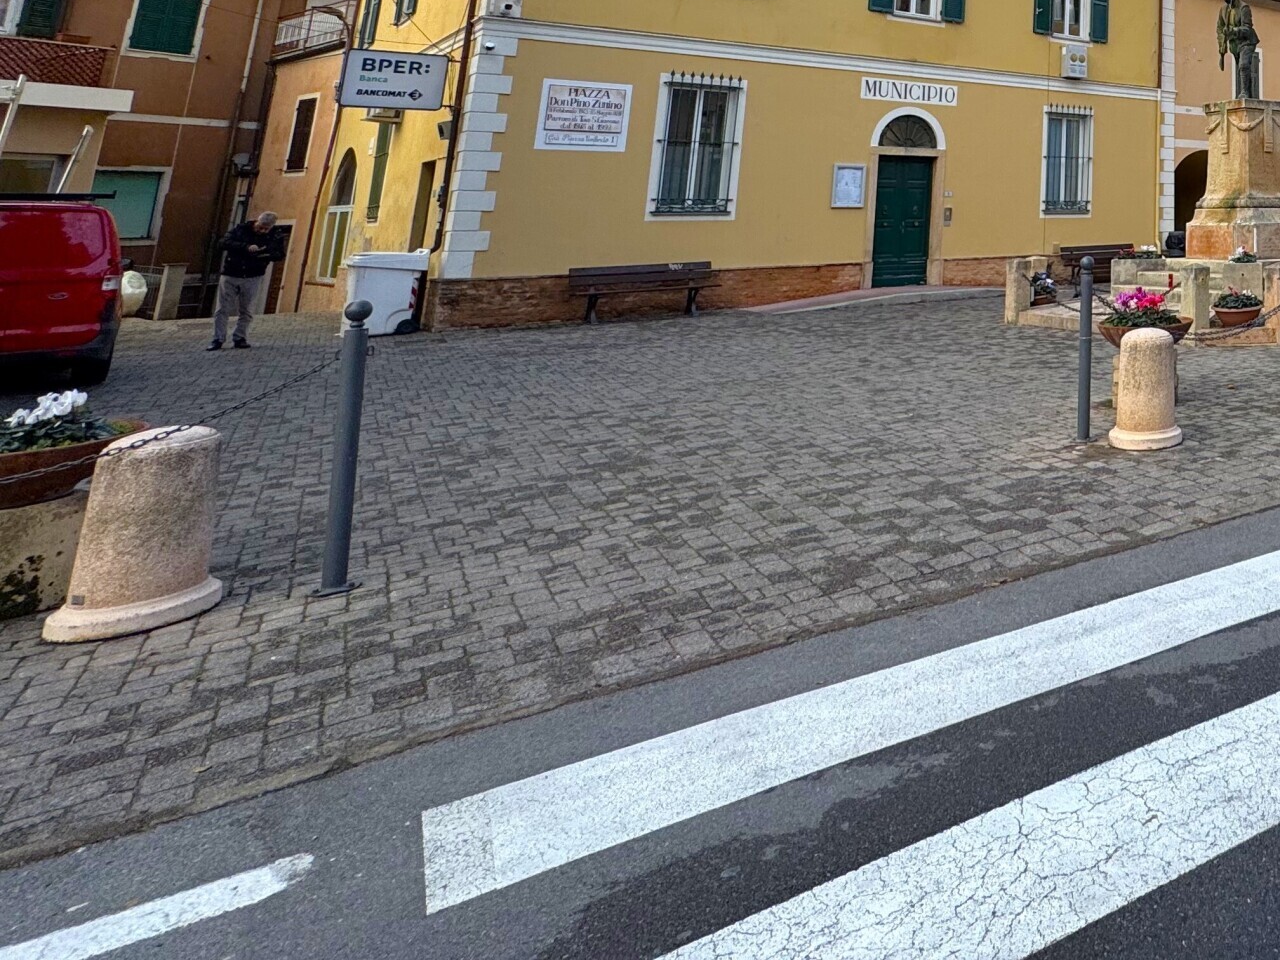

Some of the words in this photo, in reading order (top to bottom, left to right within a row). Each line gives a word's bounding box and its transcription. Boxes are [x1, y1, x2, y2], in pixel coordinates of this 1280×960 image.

[361, 57, 431, 75] BPER:
[359, 74, 388, 83] Banca
[356, 88, 407, 98] BANCOMAT
[568, 87, 611, 99] PIAZZA
[864, 79, 956, 103] MUNICIPIO
[549, 96, 569, 106] Don
[570, 97, 590, 108] Pino
